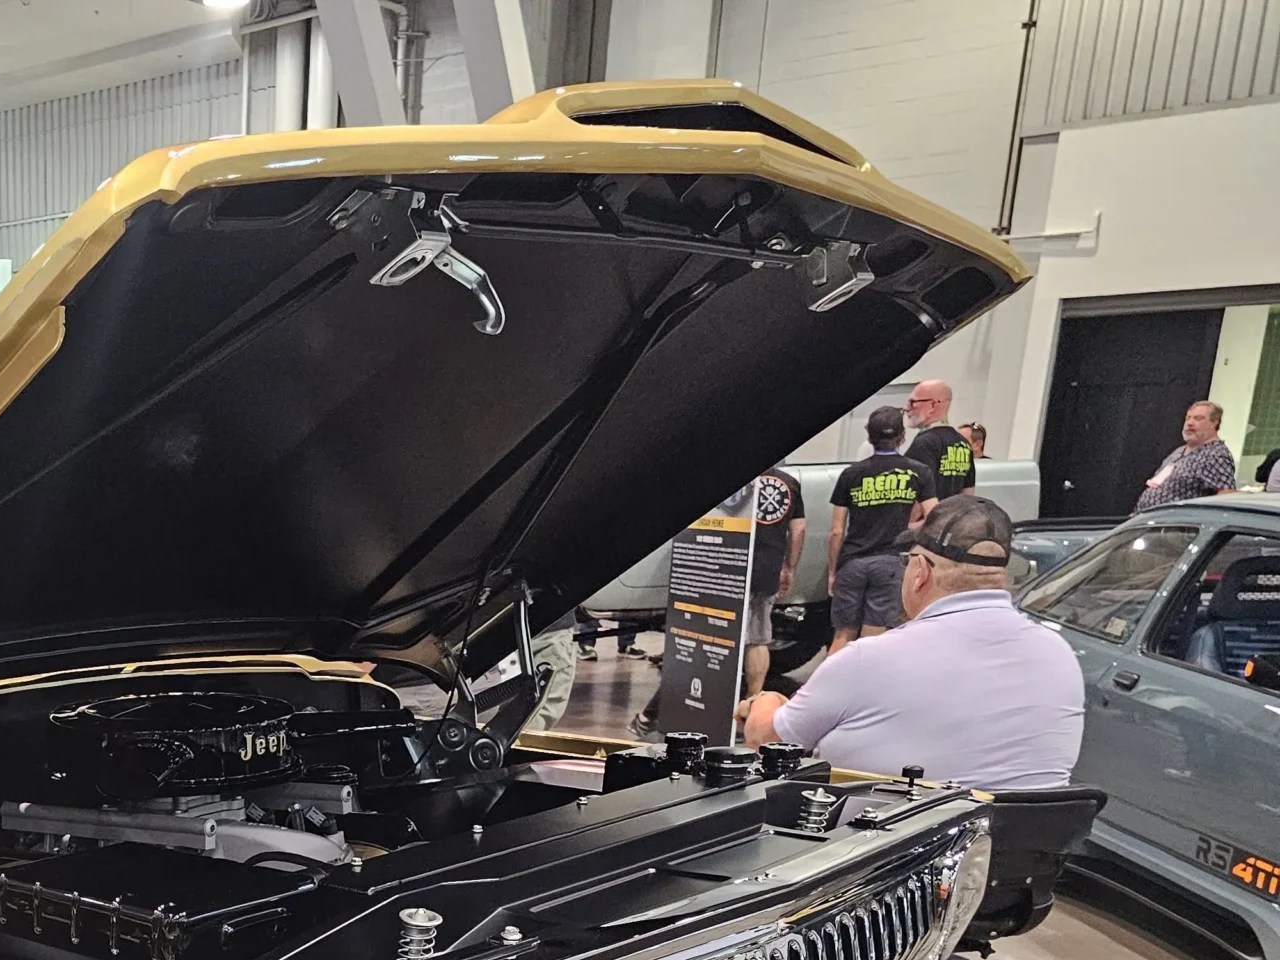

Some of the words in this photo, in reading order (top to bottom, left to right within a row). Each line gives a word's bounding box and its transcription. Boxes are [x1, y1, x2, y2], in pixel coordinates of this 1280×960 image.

[862, 474, 911, 492] BENT
[238, 730, 289, 761] Jeep
[1195, 835, 1231, 871] RS
